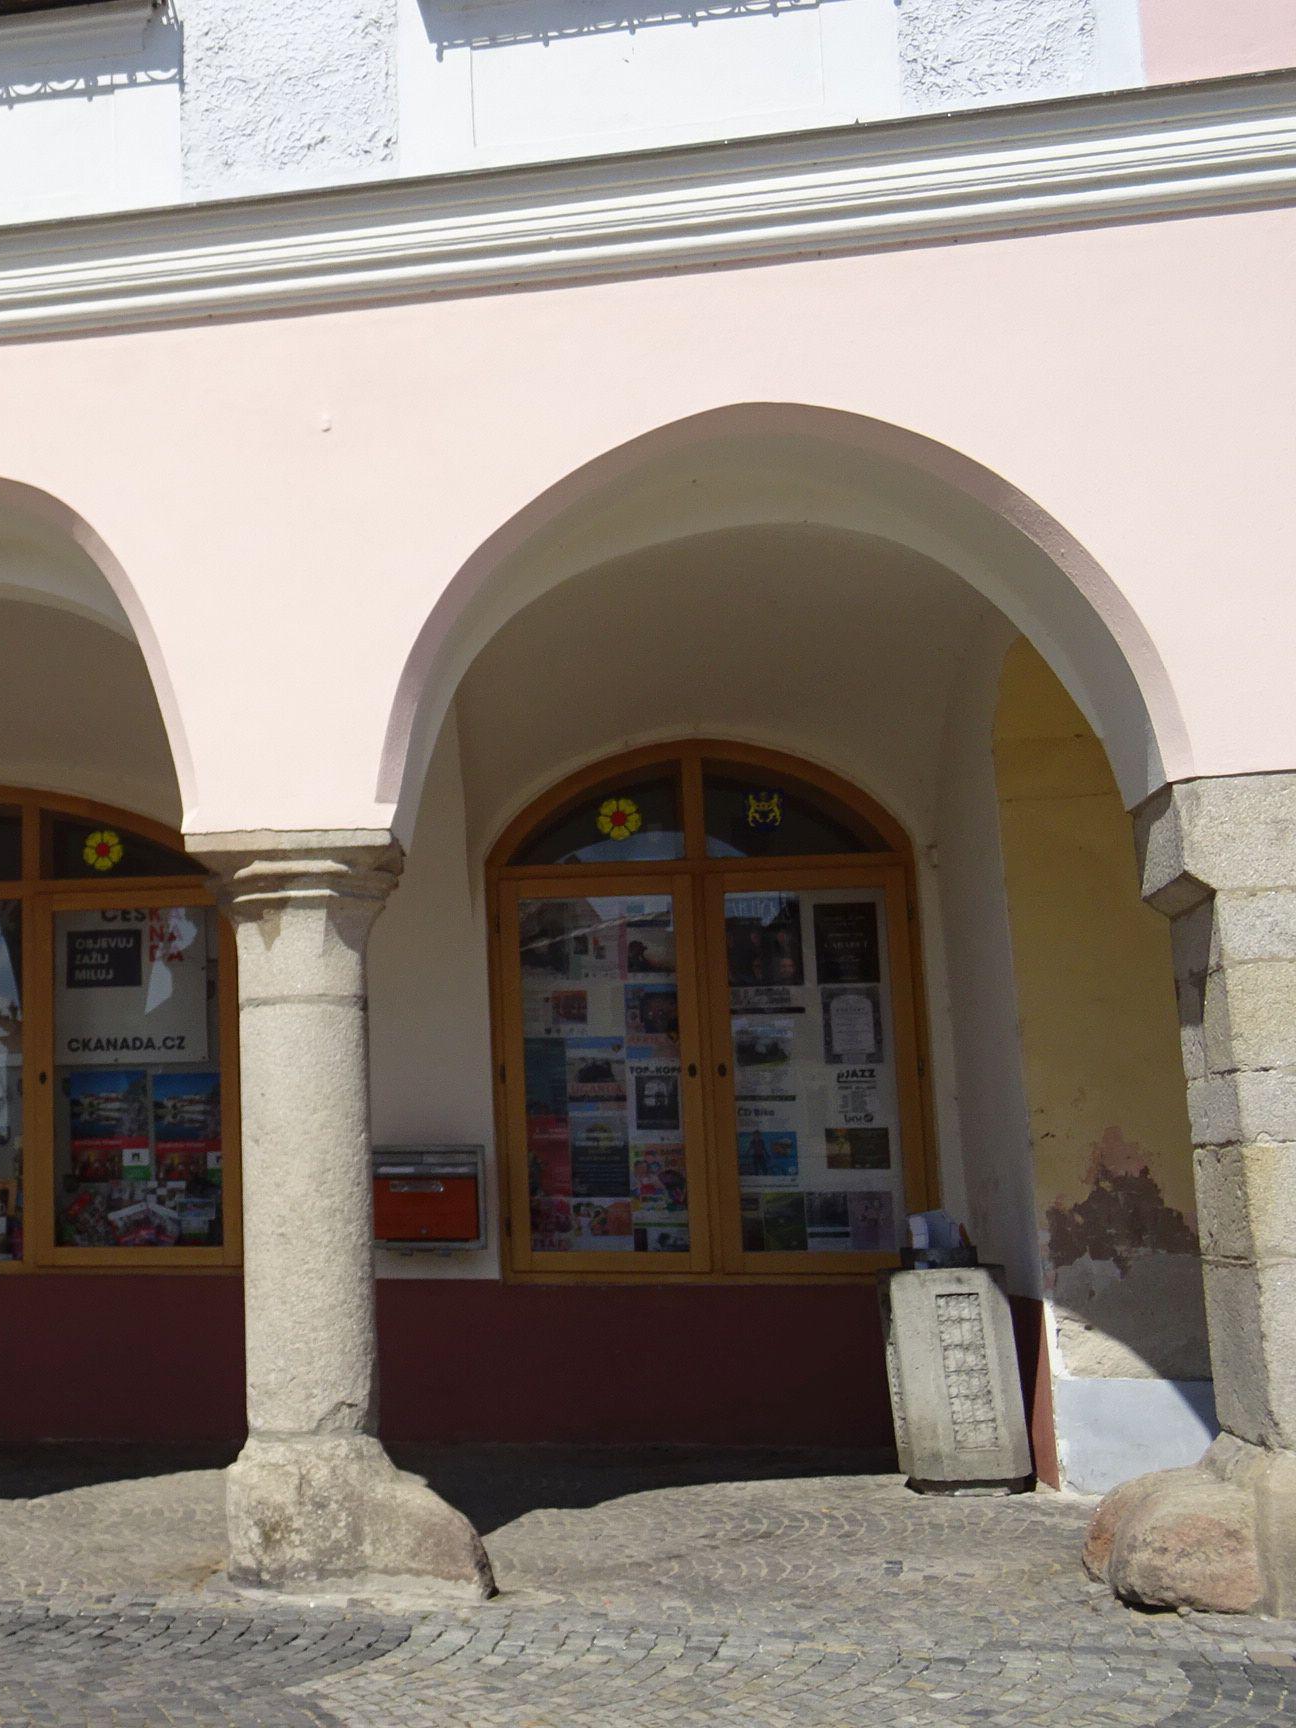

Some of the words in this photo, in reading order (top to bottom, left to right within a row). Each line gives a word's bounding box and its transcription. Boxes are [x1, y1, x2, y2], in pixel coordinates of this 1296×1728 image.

[75, 937, 134, 950] OBJEVUJ
[74, 968, 115, 981] MILUJ
[67, 1036, 186, 1052] CKANADA.CZ
